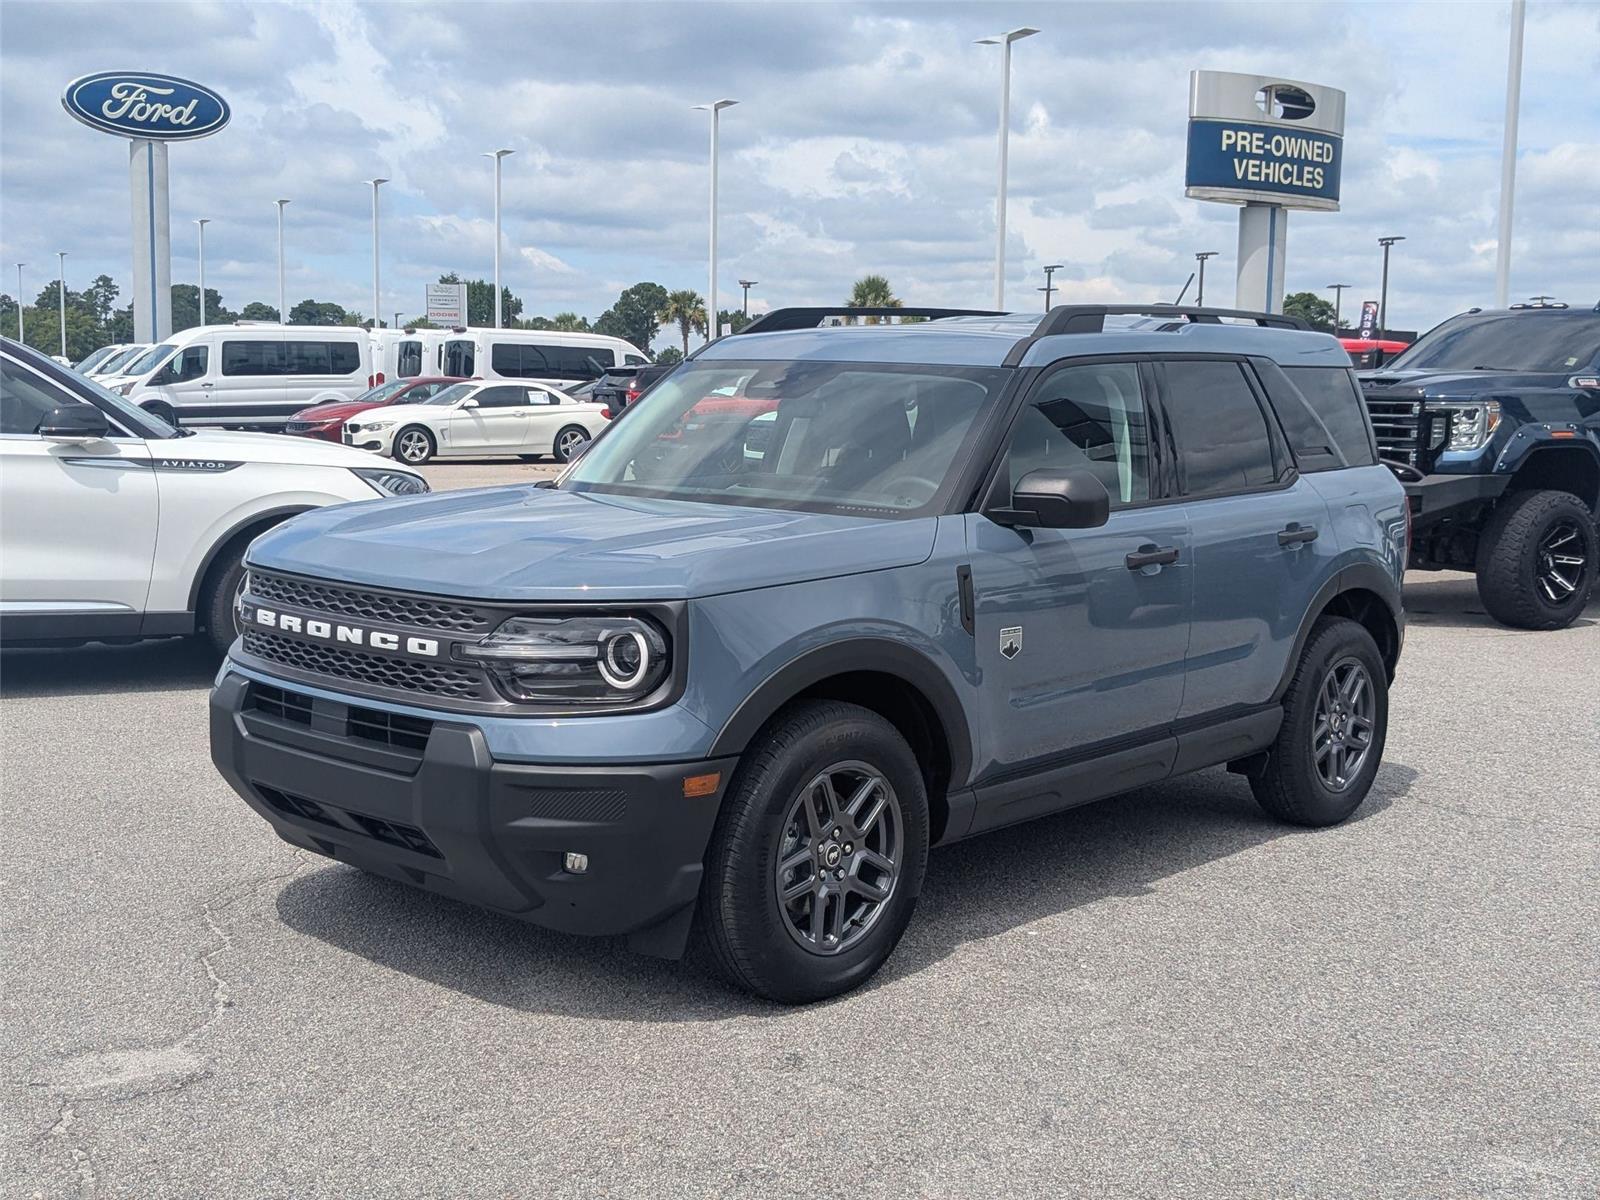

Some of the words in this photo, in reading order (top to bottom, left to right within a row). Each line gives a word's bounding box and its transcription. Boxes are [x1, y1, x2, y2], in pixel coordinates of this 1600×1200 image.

[102, 82, 199, 126] Ford
[1221, 129, 1333, 164] PRE-OWNED
[1233, 158, 1324, 190] VEHICLES
[162, 460, 226, 468] AVIATOR
[256, 608, 439, 657] BRONCO
